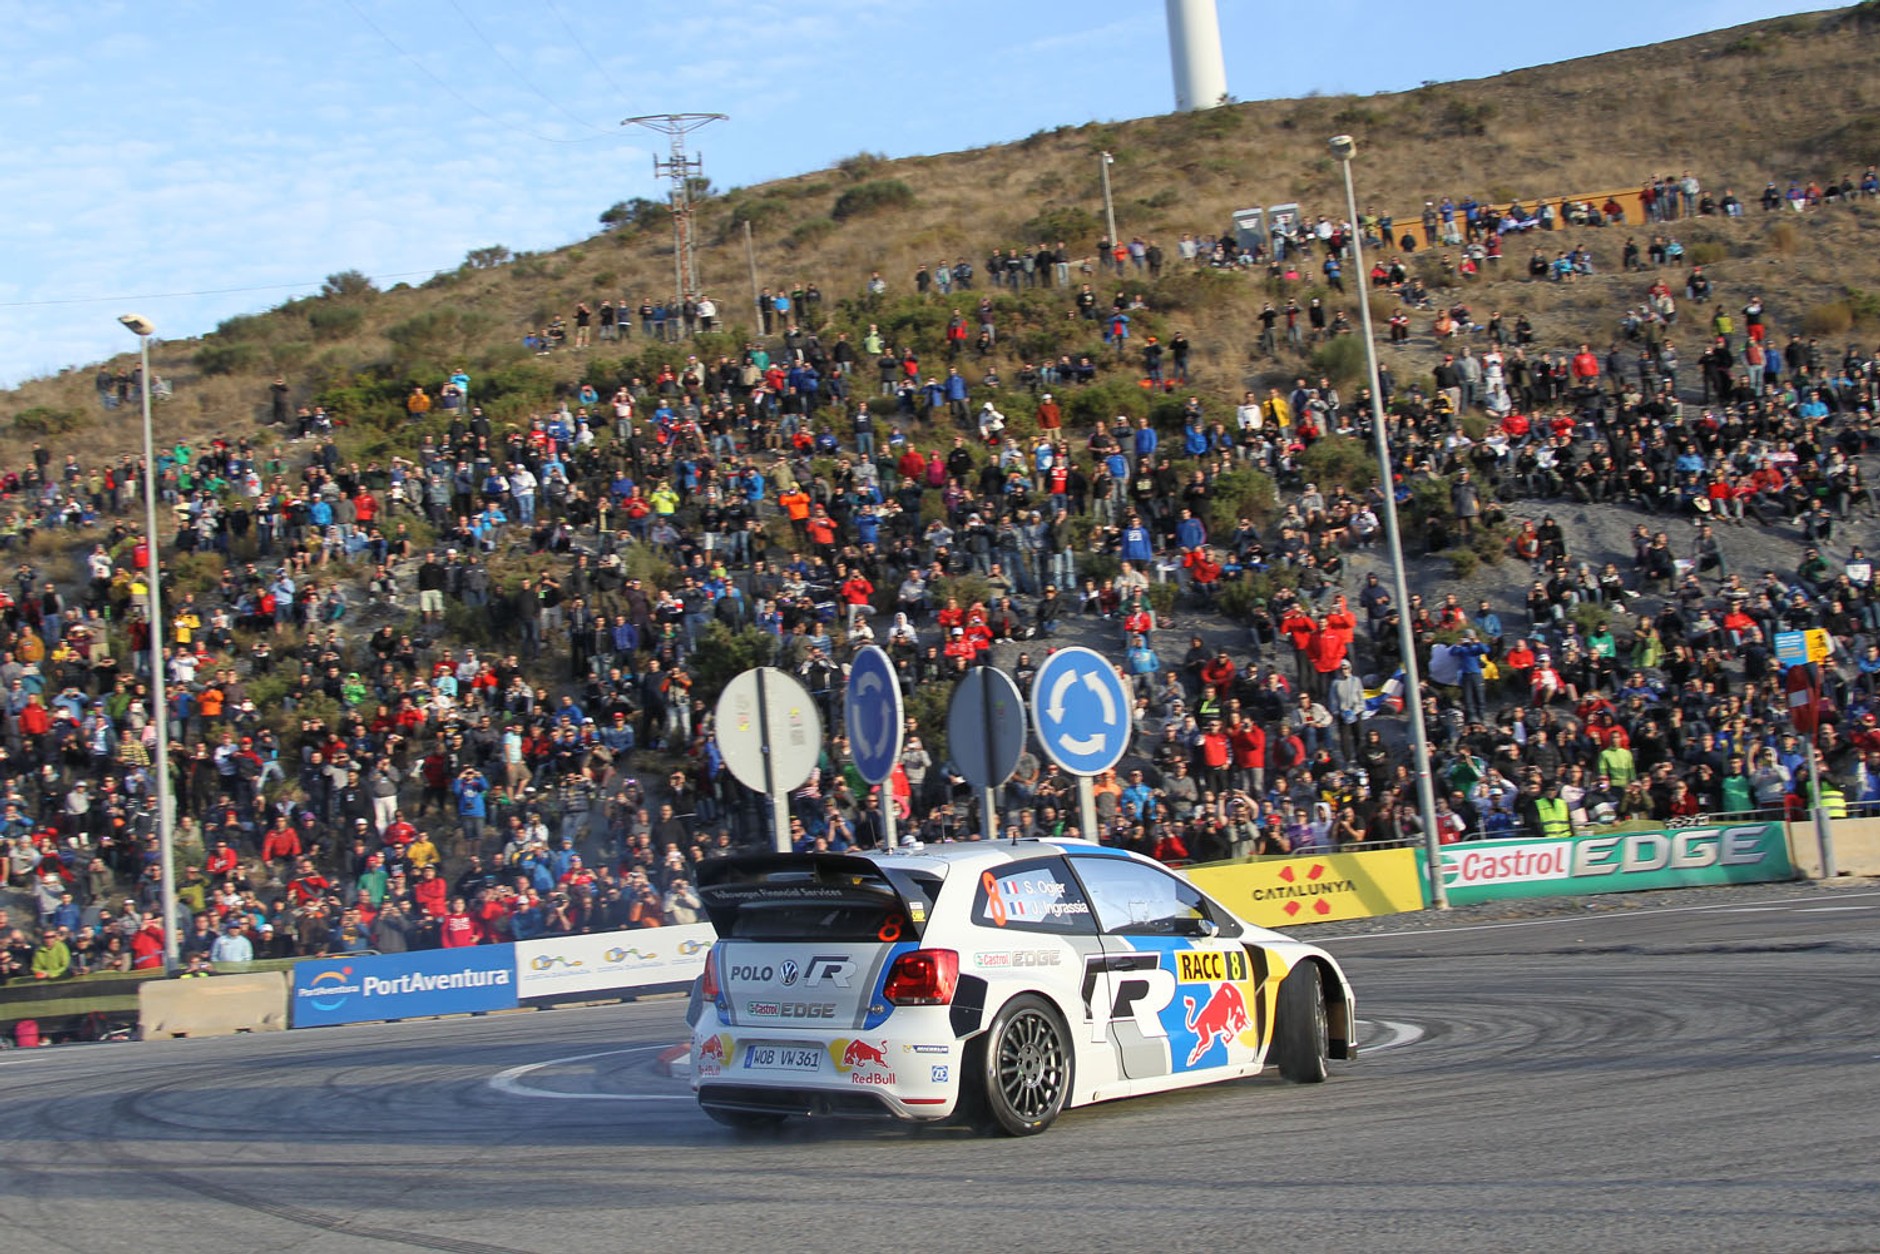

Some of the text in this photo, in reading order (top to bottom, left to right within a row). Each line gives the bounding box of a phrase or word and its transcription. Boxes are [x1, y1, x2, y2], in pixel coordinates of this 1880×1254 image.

[1462, 826, 1766, 881] Castrol EDGE
[800, 885, 842, 896] Services
[982, 871, 1006, 926] 8
[1023, 881, 1066, 897] S. Ogier
[1253, 879, 1357, 900] CATALUNYA
[984, 950, 1061, 967] Castrol EDGE
[1181, 953, 1221, 980] RACC
[1229, 952, 1241, 980] 8
[363, 968, 510, 996] PortAventura
[731, 966, 773, 981] POLO
[780, 1002, 837, 1018] EDGE
[754, 1050, 775, 1064] WOB
